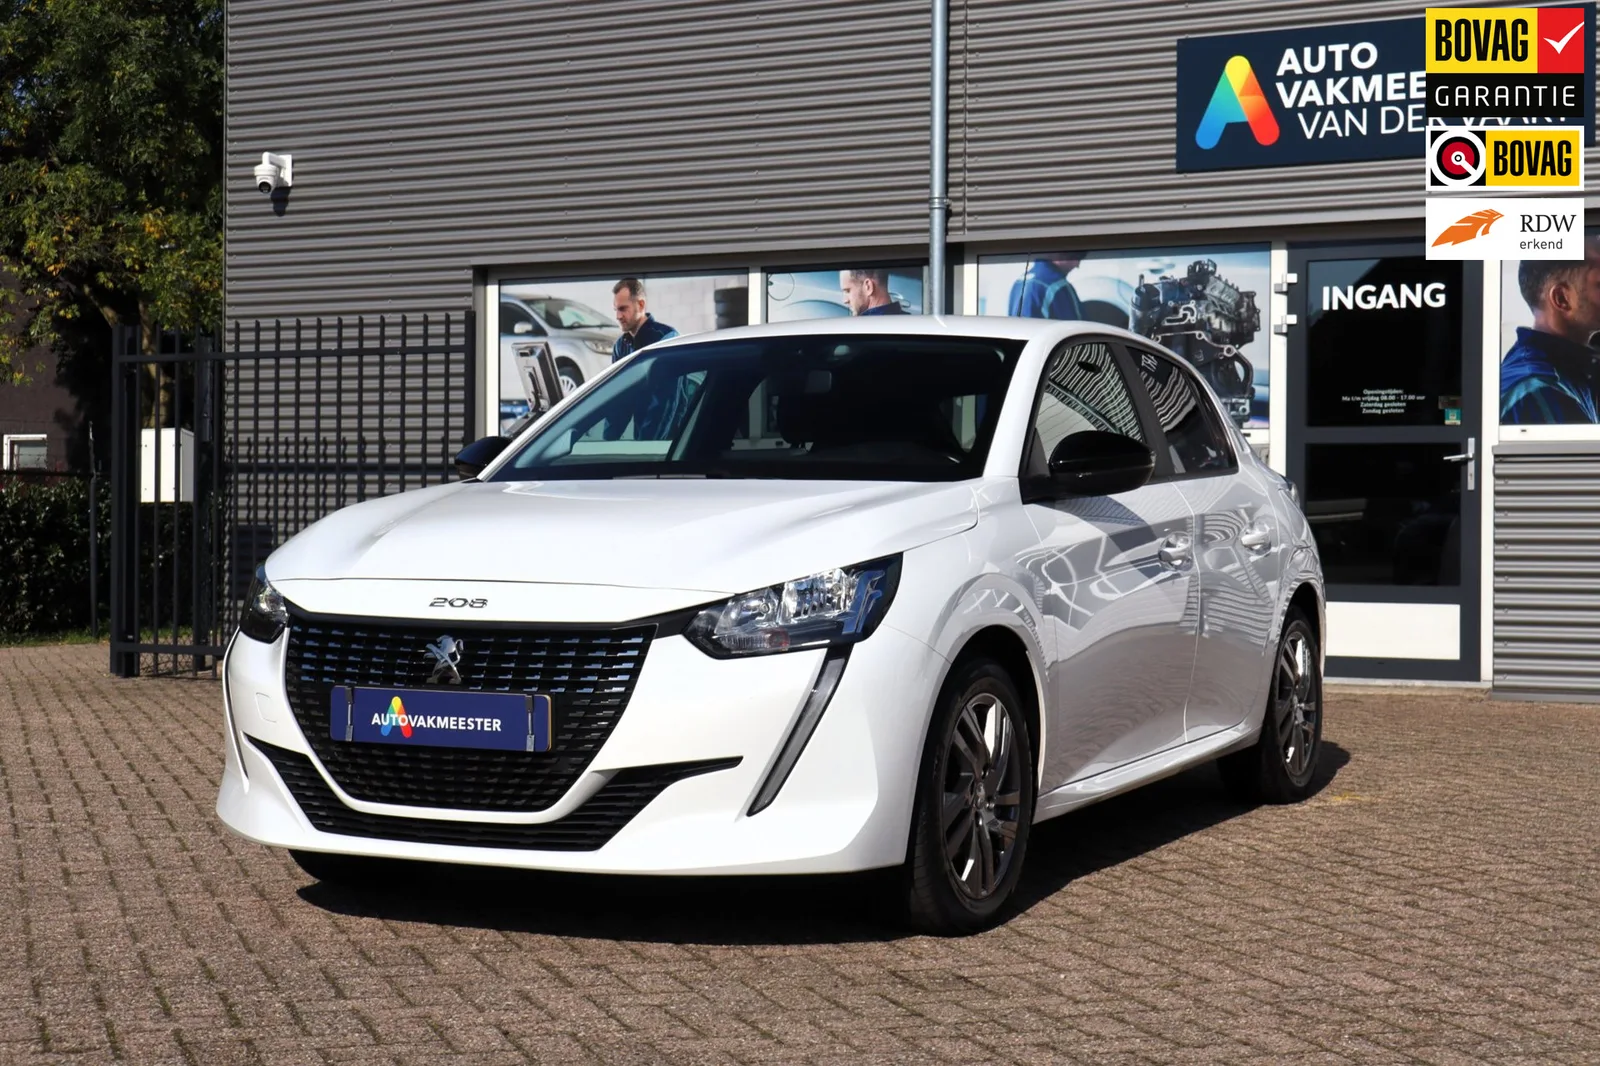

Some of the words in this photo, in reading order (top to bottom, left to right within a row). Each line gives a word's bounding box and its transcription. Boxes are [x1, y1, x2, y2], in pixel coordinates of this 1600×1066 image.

[1276, 42, 1378, 76] AUTO
[1275, 70, 1426, 109] VAKMEE
[1297, 108, 1367, 140] VAN
[1322, 282, 1446, 311] INGANG
[429, 597, 488, 608] 208
[371, 713, 502, 732] AUTOVAKMEESTER
